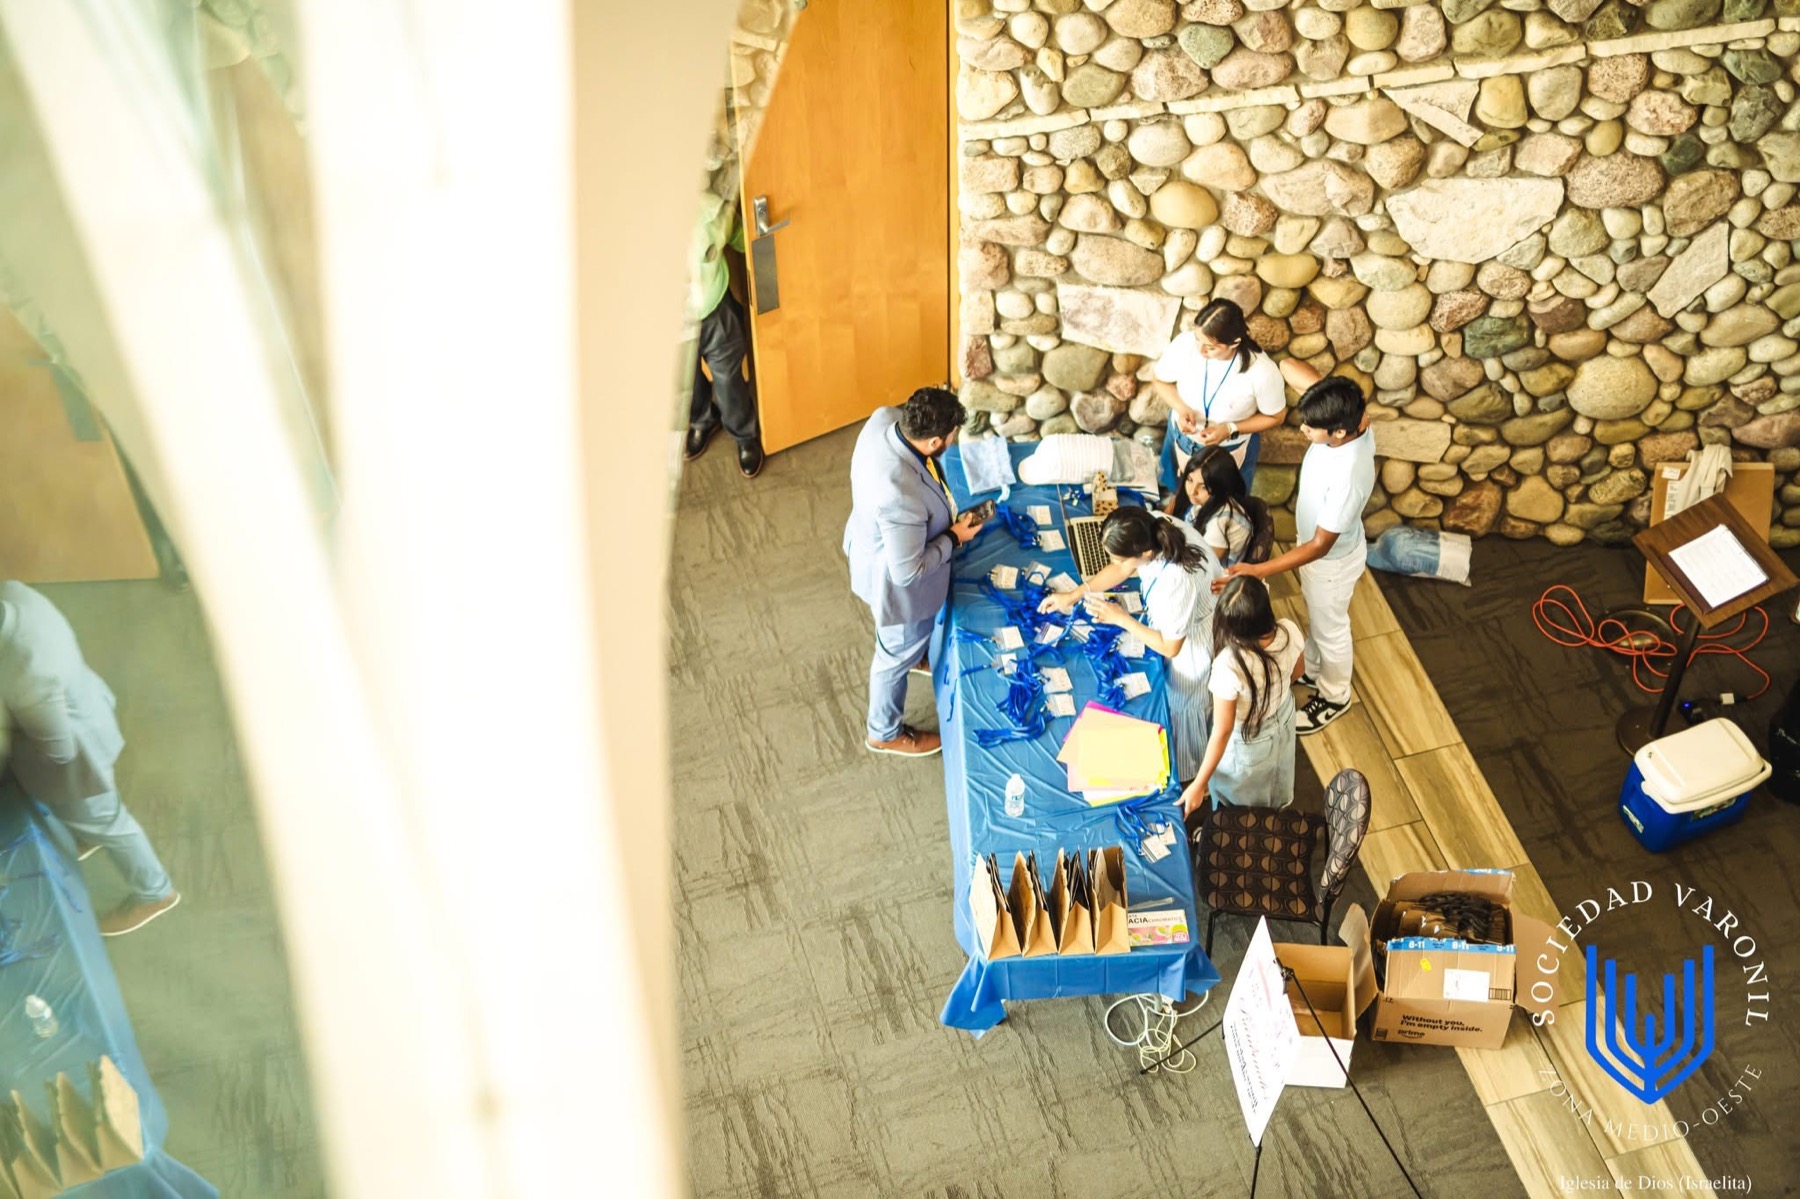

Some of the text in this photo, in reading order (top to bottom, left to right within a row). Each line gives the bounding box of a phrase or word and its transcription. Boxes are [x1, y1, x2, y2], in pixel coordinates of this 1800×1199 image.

[1400, 1019, 1416, 1027] I'm
[1417, 1021, 1449, 1031] empty
[1402, 1014, 1443, 1025] Without
[1397, 1029, 1425, 1037] prime
